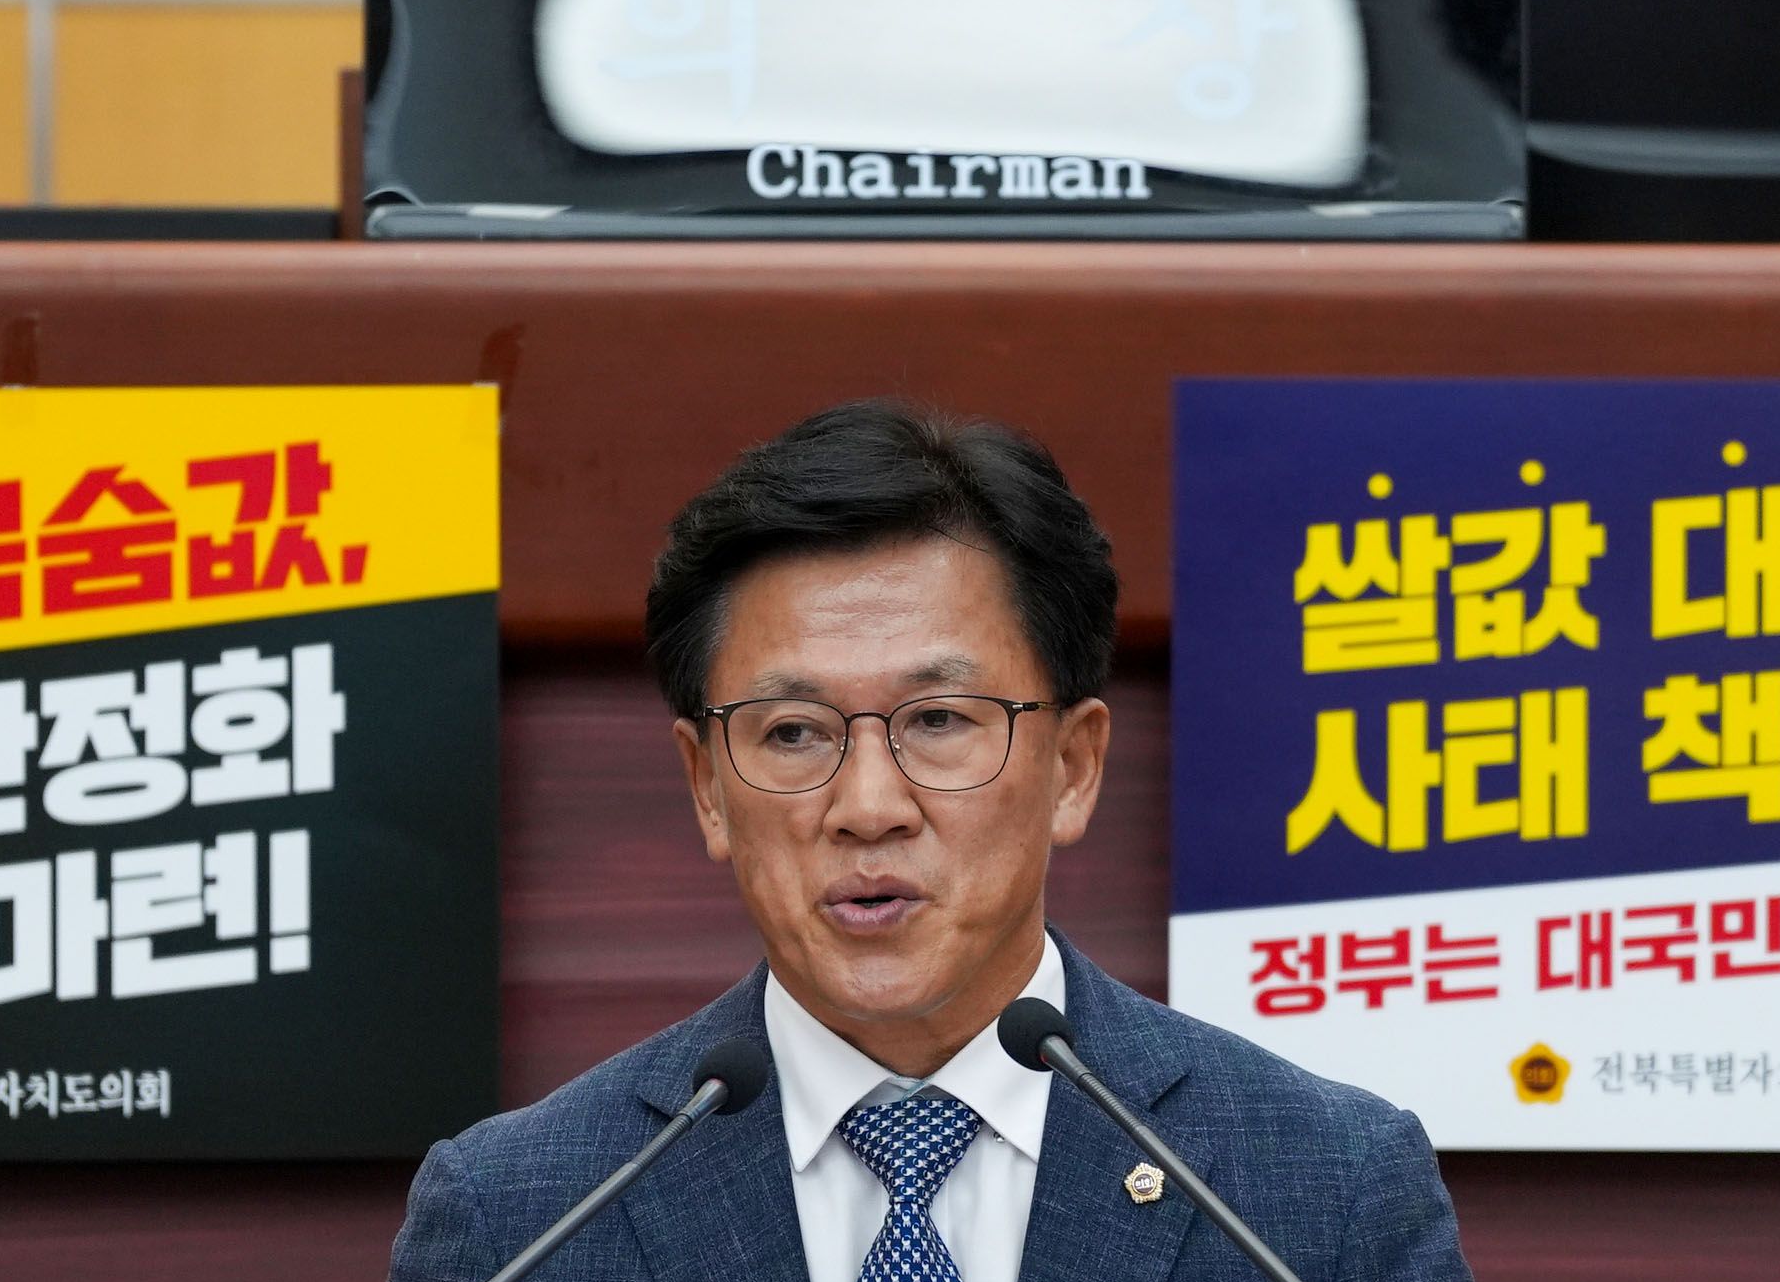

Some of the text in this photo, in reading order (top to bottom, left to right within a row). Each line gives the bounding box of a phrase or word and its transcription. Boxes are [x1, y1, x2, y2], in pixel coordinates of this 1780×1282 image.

[746, 142, 1150, 199] Chairman
[1294, 501, 1606, 674] 쌀값
[1286, 687, 1589, 854] 사태
[1248, 923, 1502, 1018] 정부는
